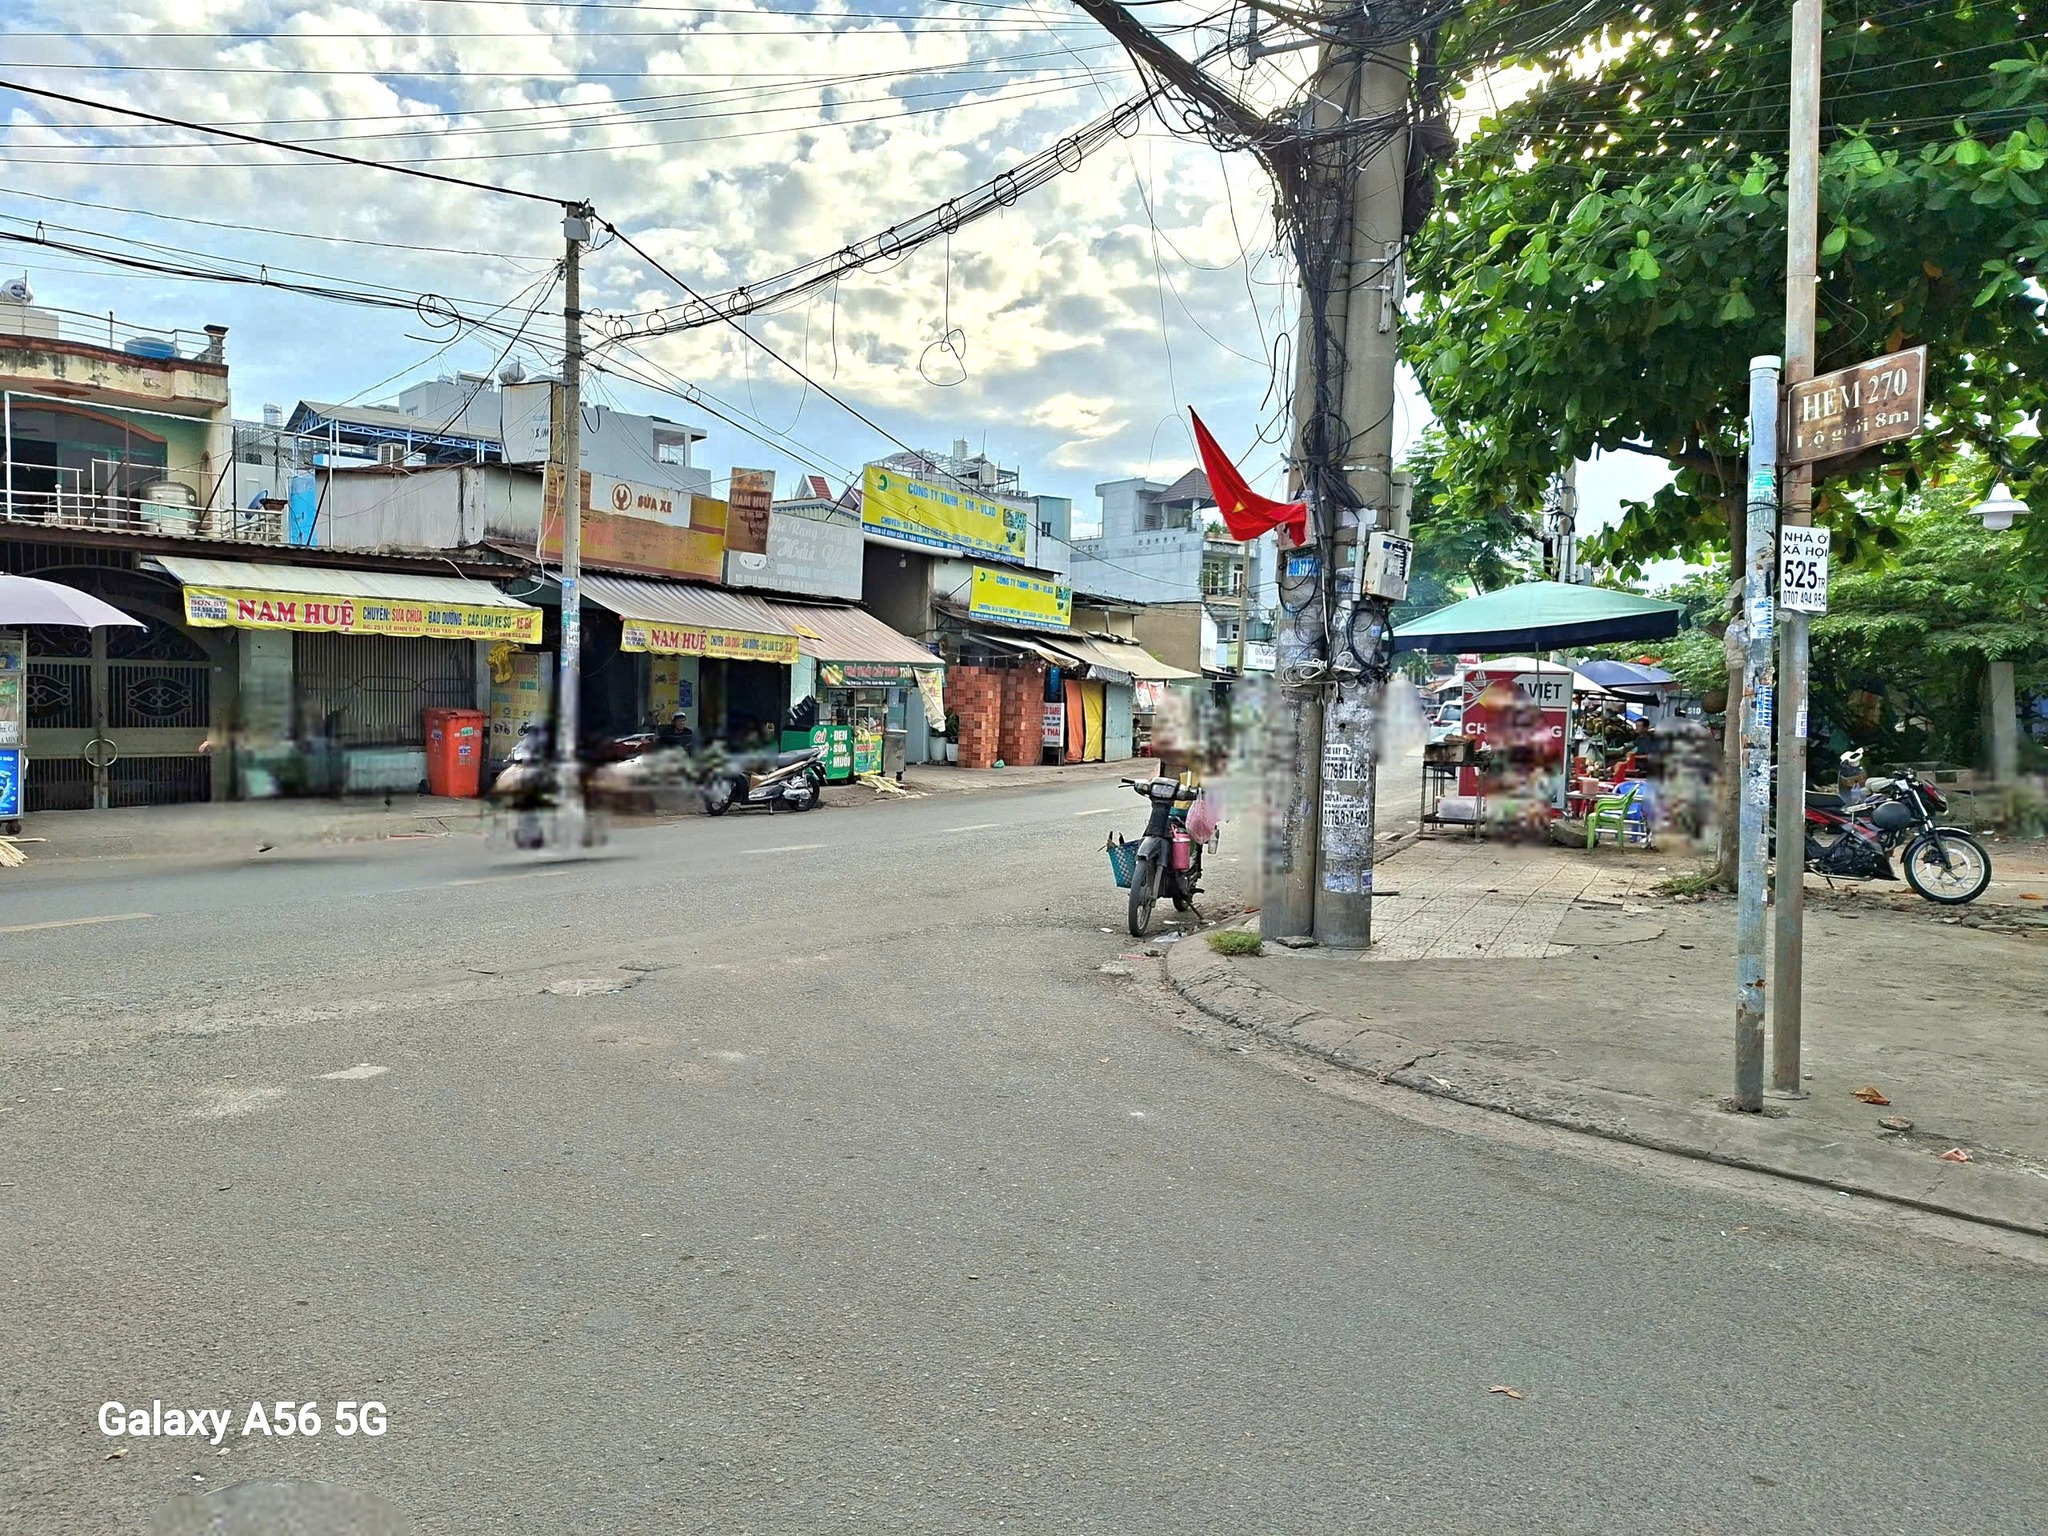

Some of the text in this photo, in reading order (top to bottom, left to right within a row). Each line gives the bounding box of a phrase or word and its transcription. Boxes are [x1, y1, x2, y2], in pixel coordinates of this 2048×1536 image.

[1803, 367, 1908, 421] HẺM 270
[1875, 410, 1909, 428] 8m
[637, 494, 672, 513] SỬA XE
[908, 482, 929, 499] CÔNG
[931, 489, 940, 500] TY
[941, 491, 959, 507] TNHH
[1783, 543, 1801, 555] XÃ
[1784, 531, 1829, 545] NHÀ Ở
[1784, 560, 1826, 590] 525 TR
[237, 599, 354, 632] NAM HUỆ
[363, 604, 391, 621] CHUYÊN:
[391, 605, 405, 622] SỬA
[405, 606, 423, 624] CHỮA
[428, 607, 440, 625] BẢO
[441, 610, 463, 627] DƯỠNG
[467, 610, 480, 628] CÁC
[480, 614, 494, 631] LOẠI
[494, 615, 503, 628] XE
[503, 611, 512, 629] SỐ
[651, 629, 679, 649] NAM
[1528, 680, 1563, 702] VIỆT
